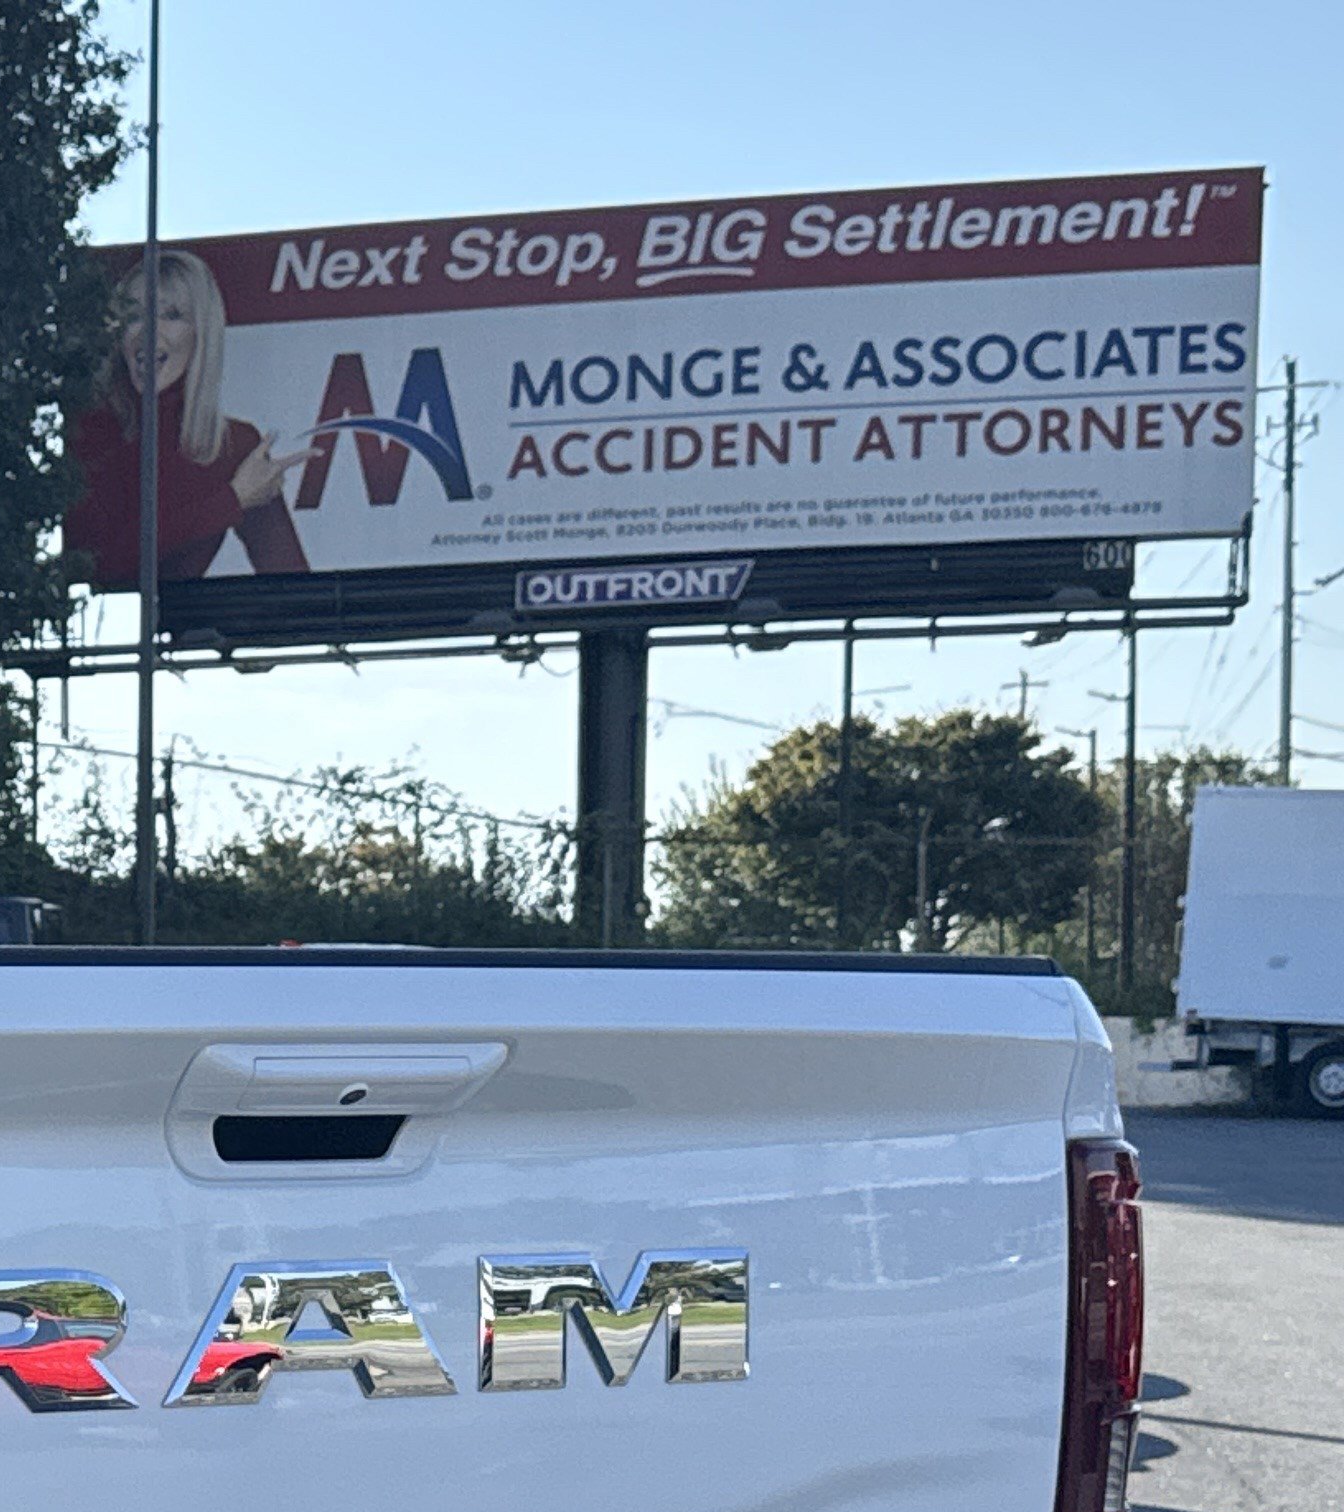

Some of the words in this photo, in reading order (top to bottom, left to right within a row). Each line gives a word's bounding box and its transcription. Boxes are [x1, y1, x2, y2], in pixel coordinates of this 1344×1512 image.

[270, 235, 429, 293] Next
[443, 227, 621, 288] Stop,
[636, 208, 768, 268] BIG
[784, 183, 1208, 259] Settlement!
[509, 346, 761, 409] MONGE
[781, 342, 830, 393] &
[843, 321, 1247, 390] ASSOCIATES
[507, 417, 837, 481] ACCIDENT
[852, 399, 1245, 462] ATTORNEYS
[527, 565, 738, 602] OUTFRONT
